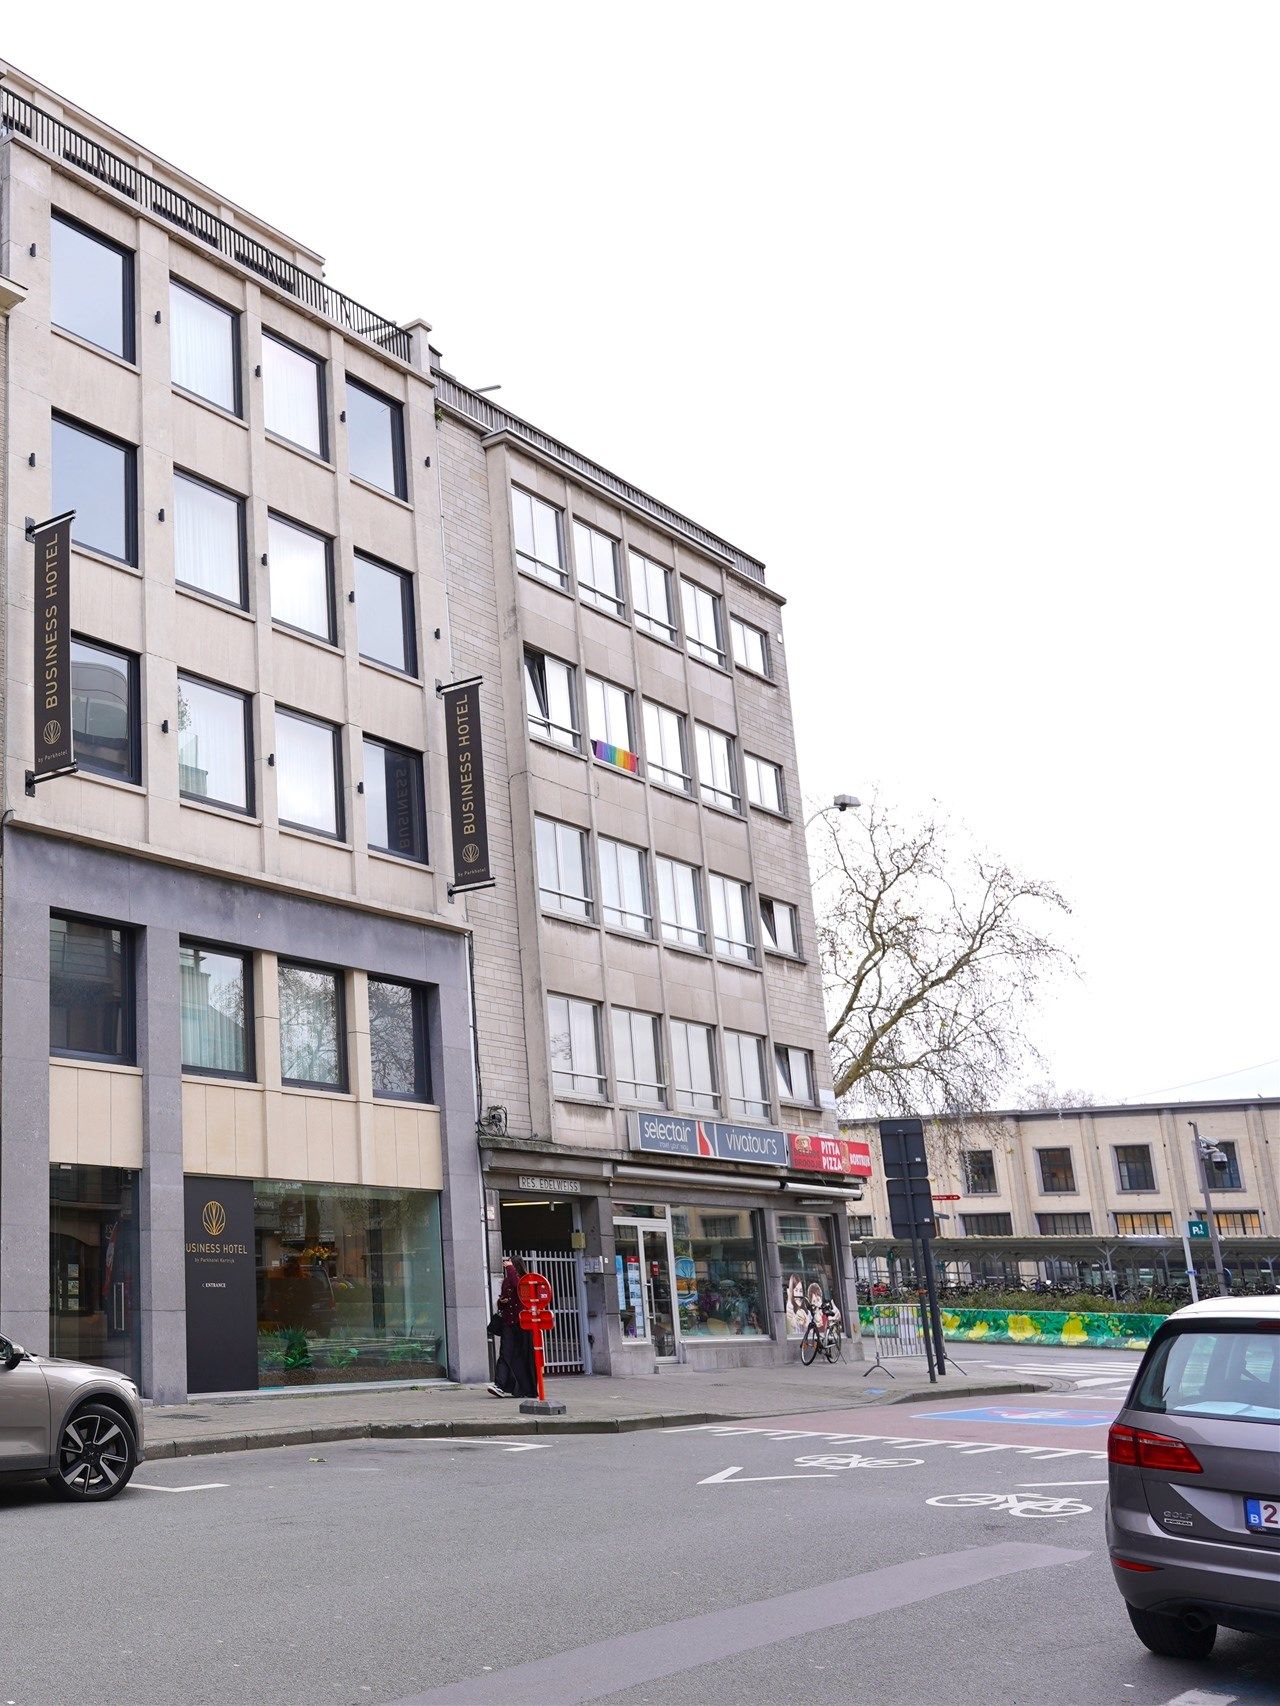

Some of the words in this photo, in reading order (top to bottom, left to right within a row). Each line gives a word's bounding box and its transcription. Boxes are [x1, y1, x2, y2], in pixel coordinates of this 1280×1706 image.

[45, 533, 58, 599] HOTEL
[45, 605, 58, 709] BUSINESS
[456, 693, 470, 747] HOTEL
[459, 752, 476, 835] BUSINESS
[643, 1118, 692, 1142] selectair
[725, 1130, 778, 1156] vivatours
[820, 1140, 840, 1156] PITTA
[822, 1156, 843, 1171] PIZZA
[539, 1178, 579, 1191] EDELWEISS
[185, 1243, 221, 1254] USINESS
[222, 1244, 248, 1255] HOTEL
[1163, 1510, 1193, 1520] GOLF
[1250, 1513, 1260, 1524] B
